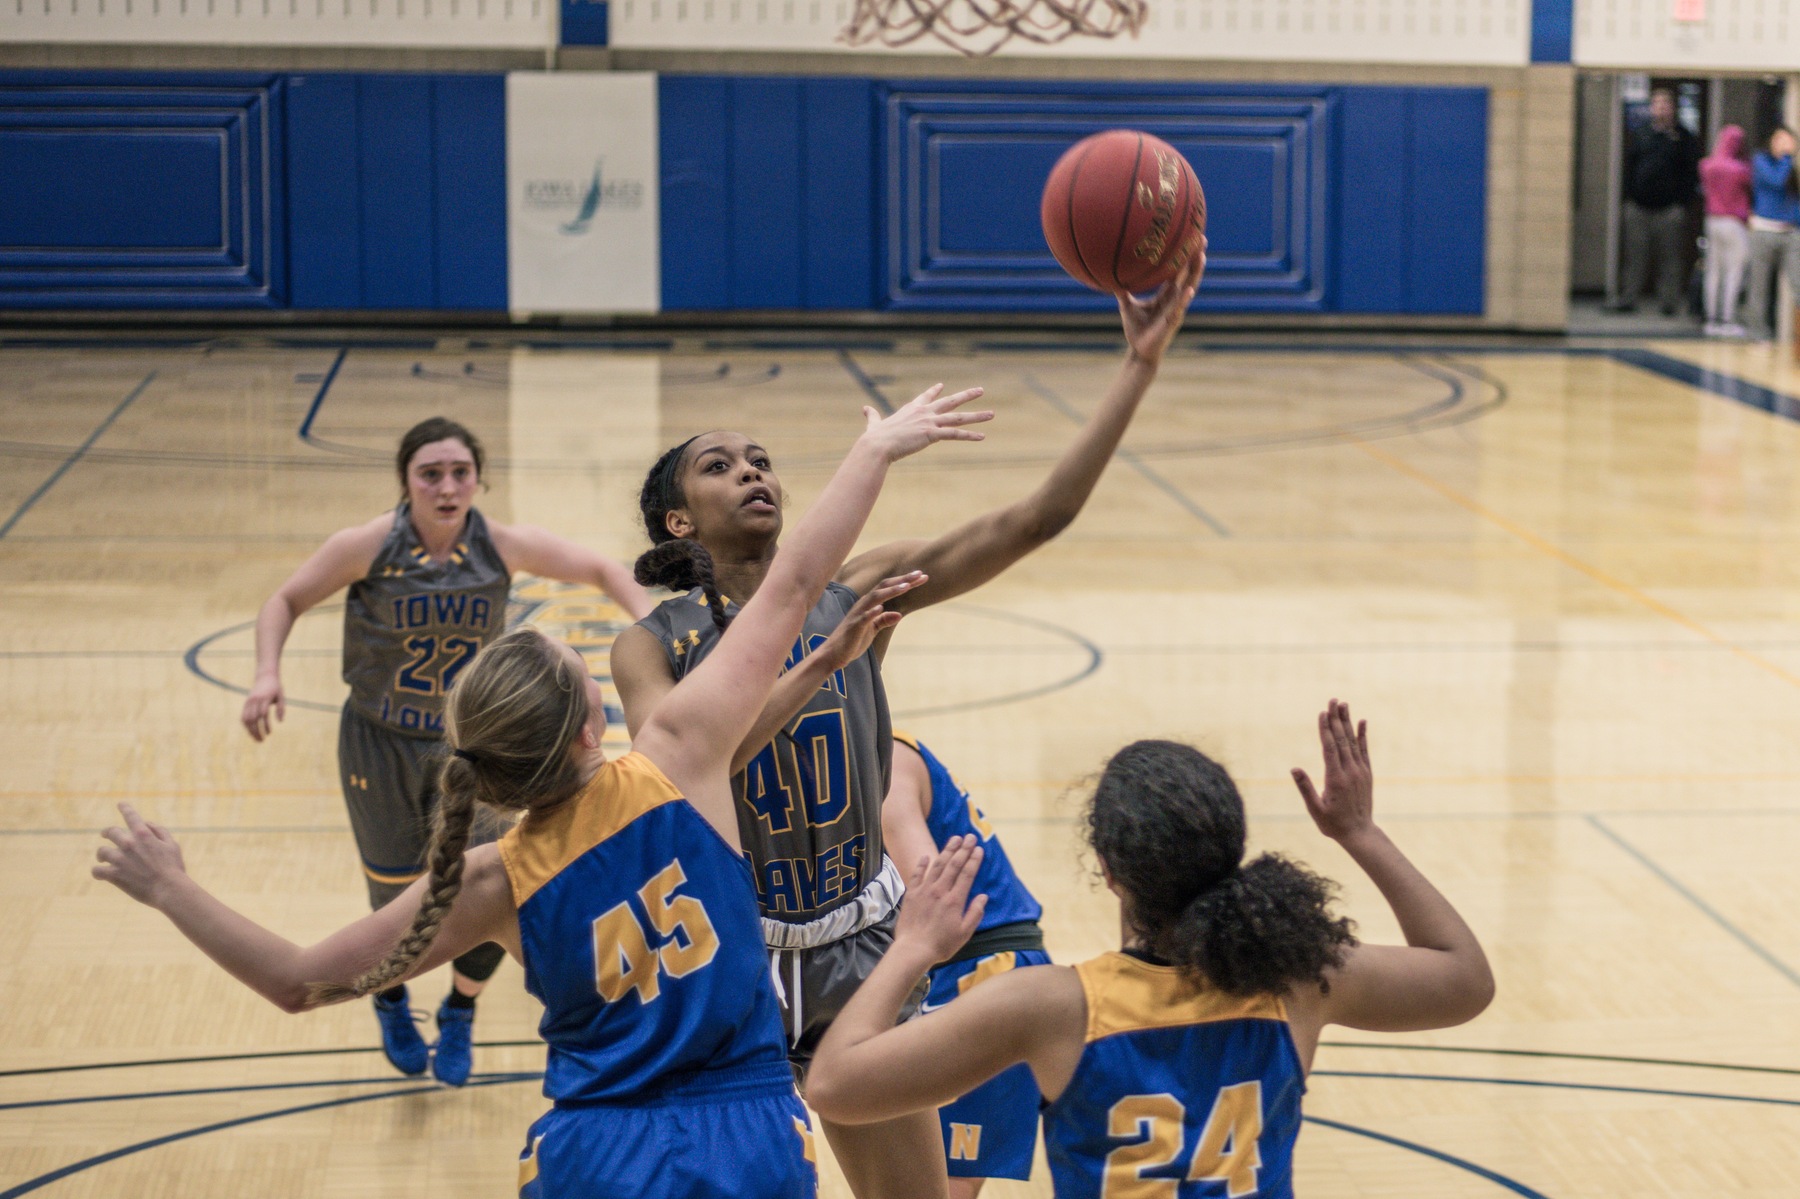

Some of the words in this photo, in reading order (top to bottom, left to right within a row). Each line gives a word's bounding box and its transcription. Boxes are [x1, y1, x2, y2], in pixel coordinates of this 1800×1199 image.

[392, 592, 491, 633] IOWA
[743, 707, 851, 836] 40
[593, 857, 721, 1006] 45
[949, 1122, 983, 1161] N
[1102, 1079, 1263, 1199] 24
